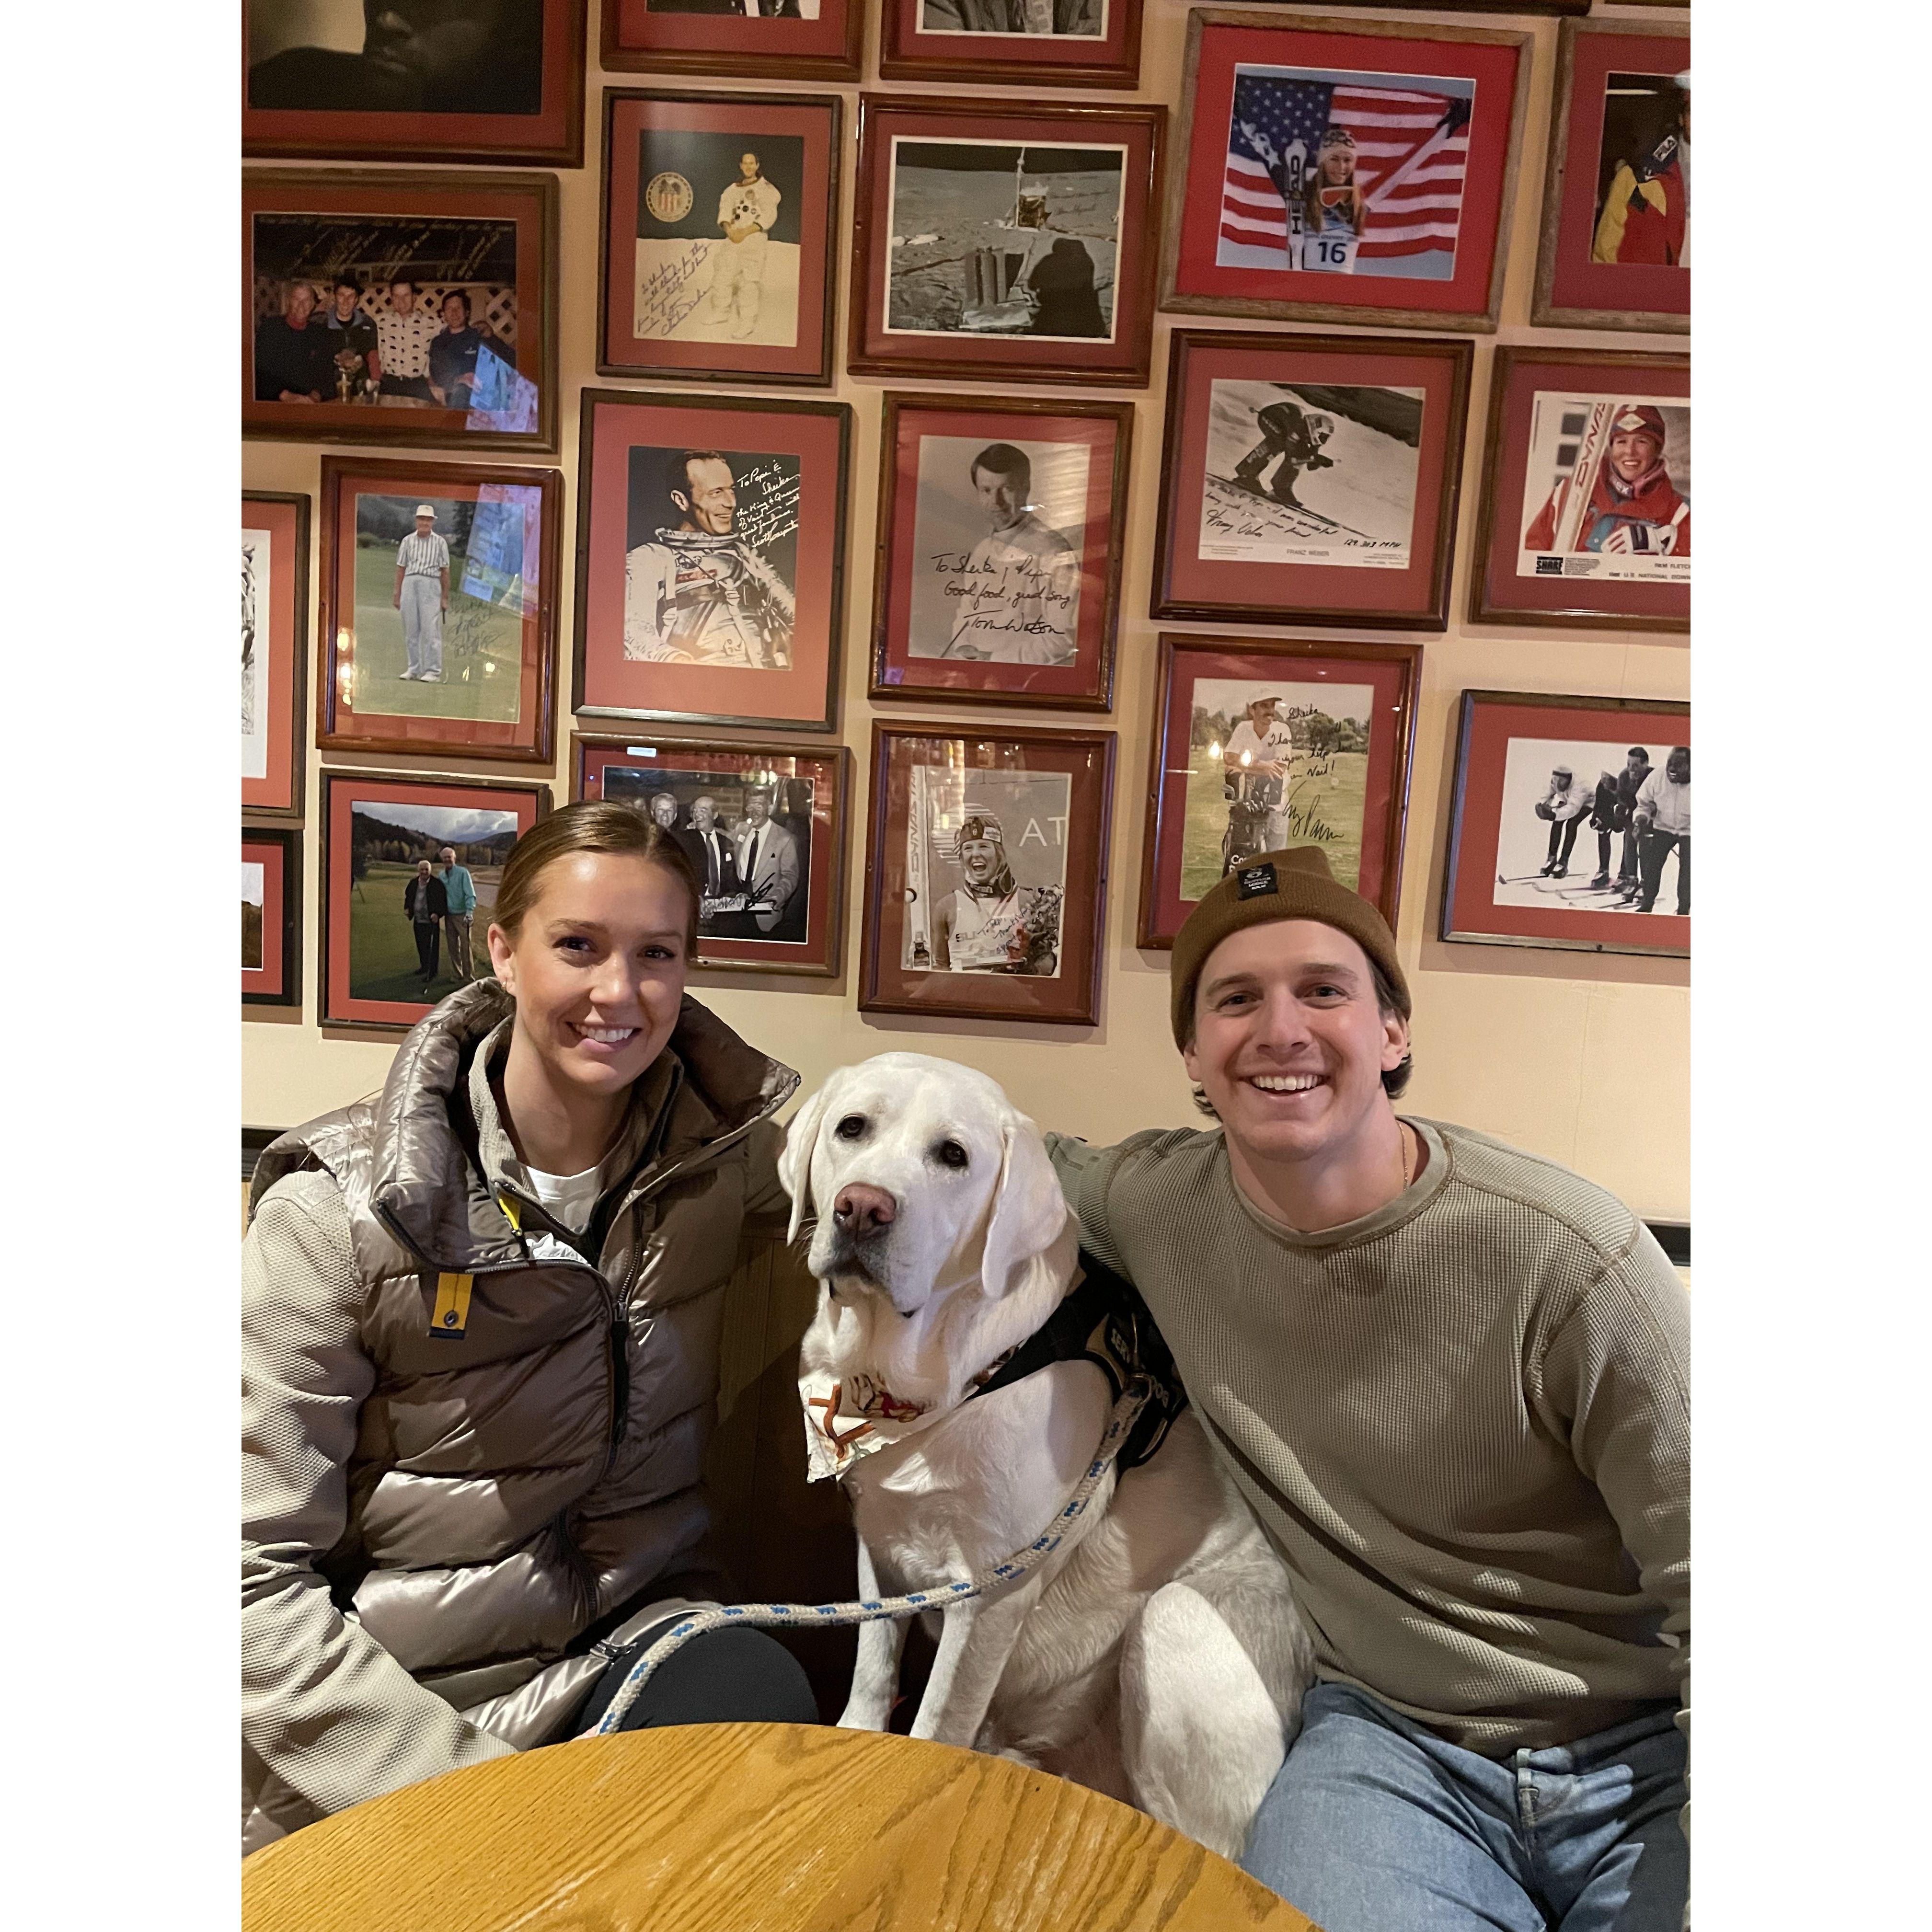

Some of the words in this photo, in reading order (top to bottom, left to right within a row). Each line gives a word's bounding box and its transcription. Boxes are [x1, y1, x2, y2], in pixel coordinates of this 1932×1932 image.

[1318, 242, 1346, 264] 16
[737, 474, 749, 487] To
[736, 508, 748, 518] the
[750, 502, 770, 511] King
[931, 553, 955, 573] To
[944, 580, 978, 596] Good
[1019, 816, 1067, 847] AT
